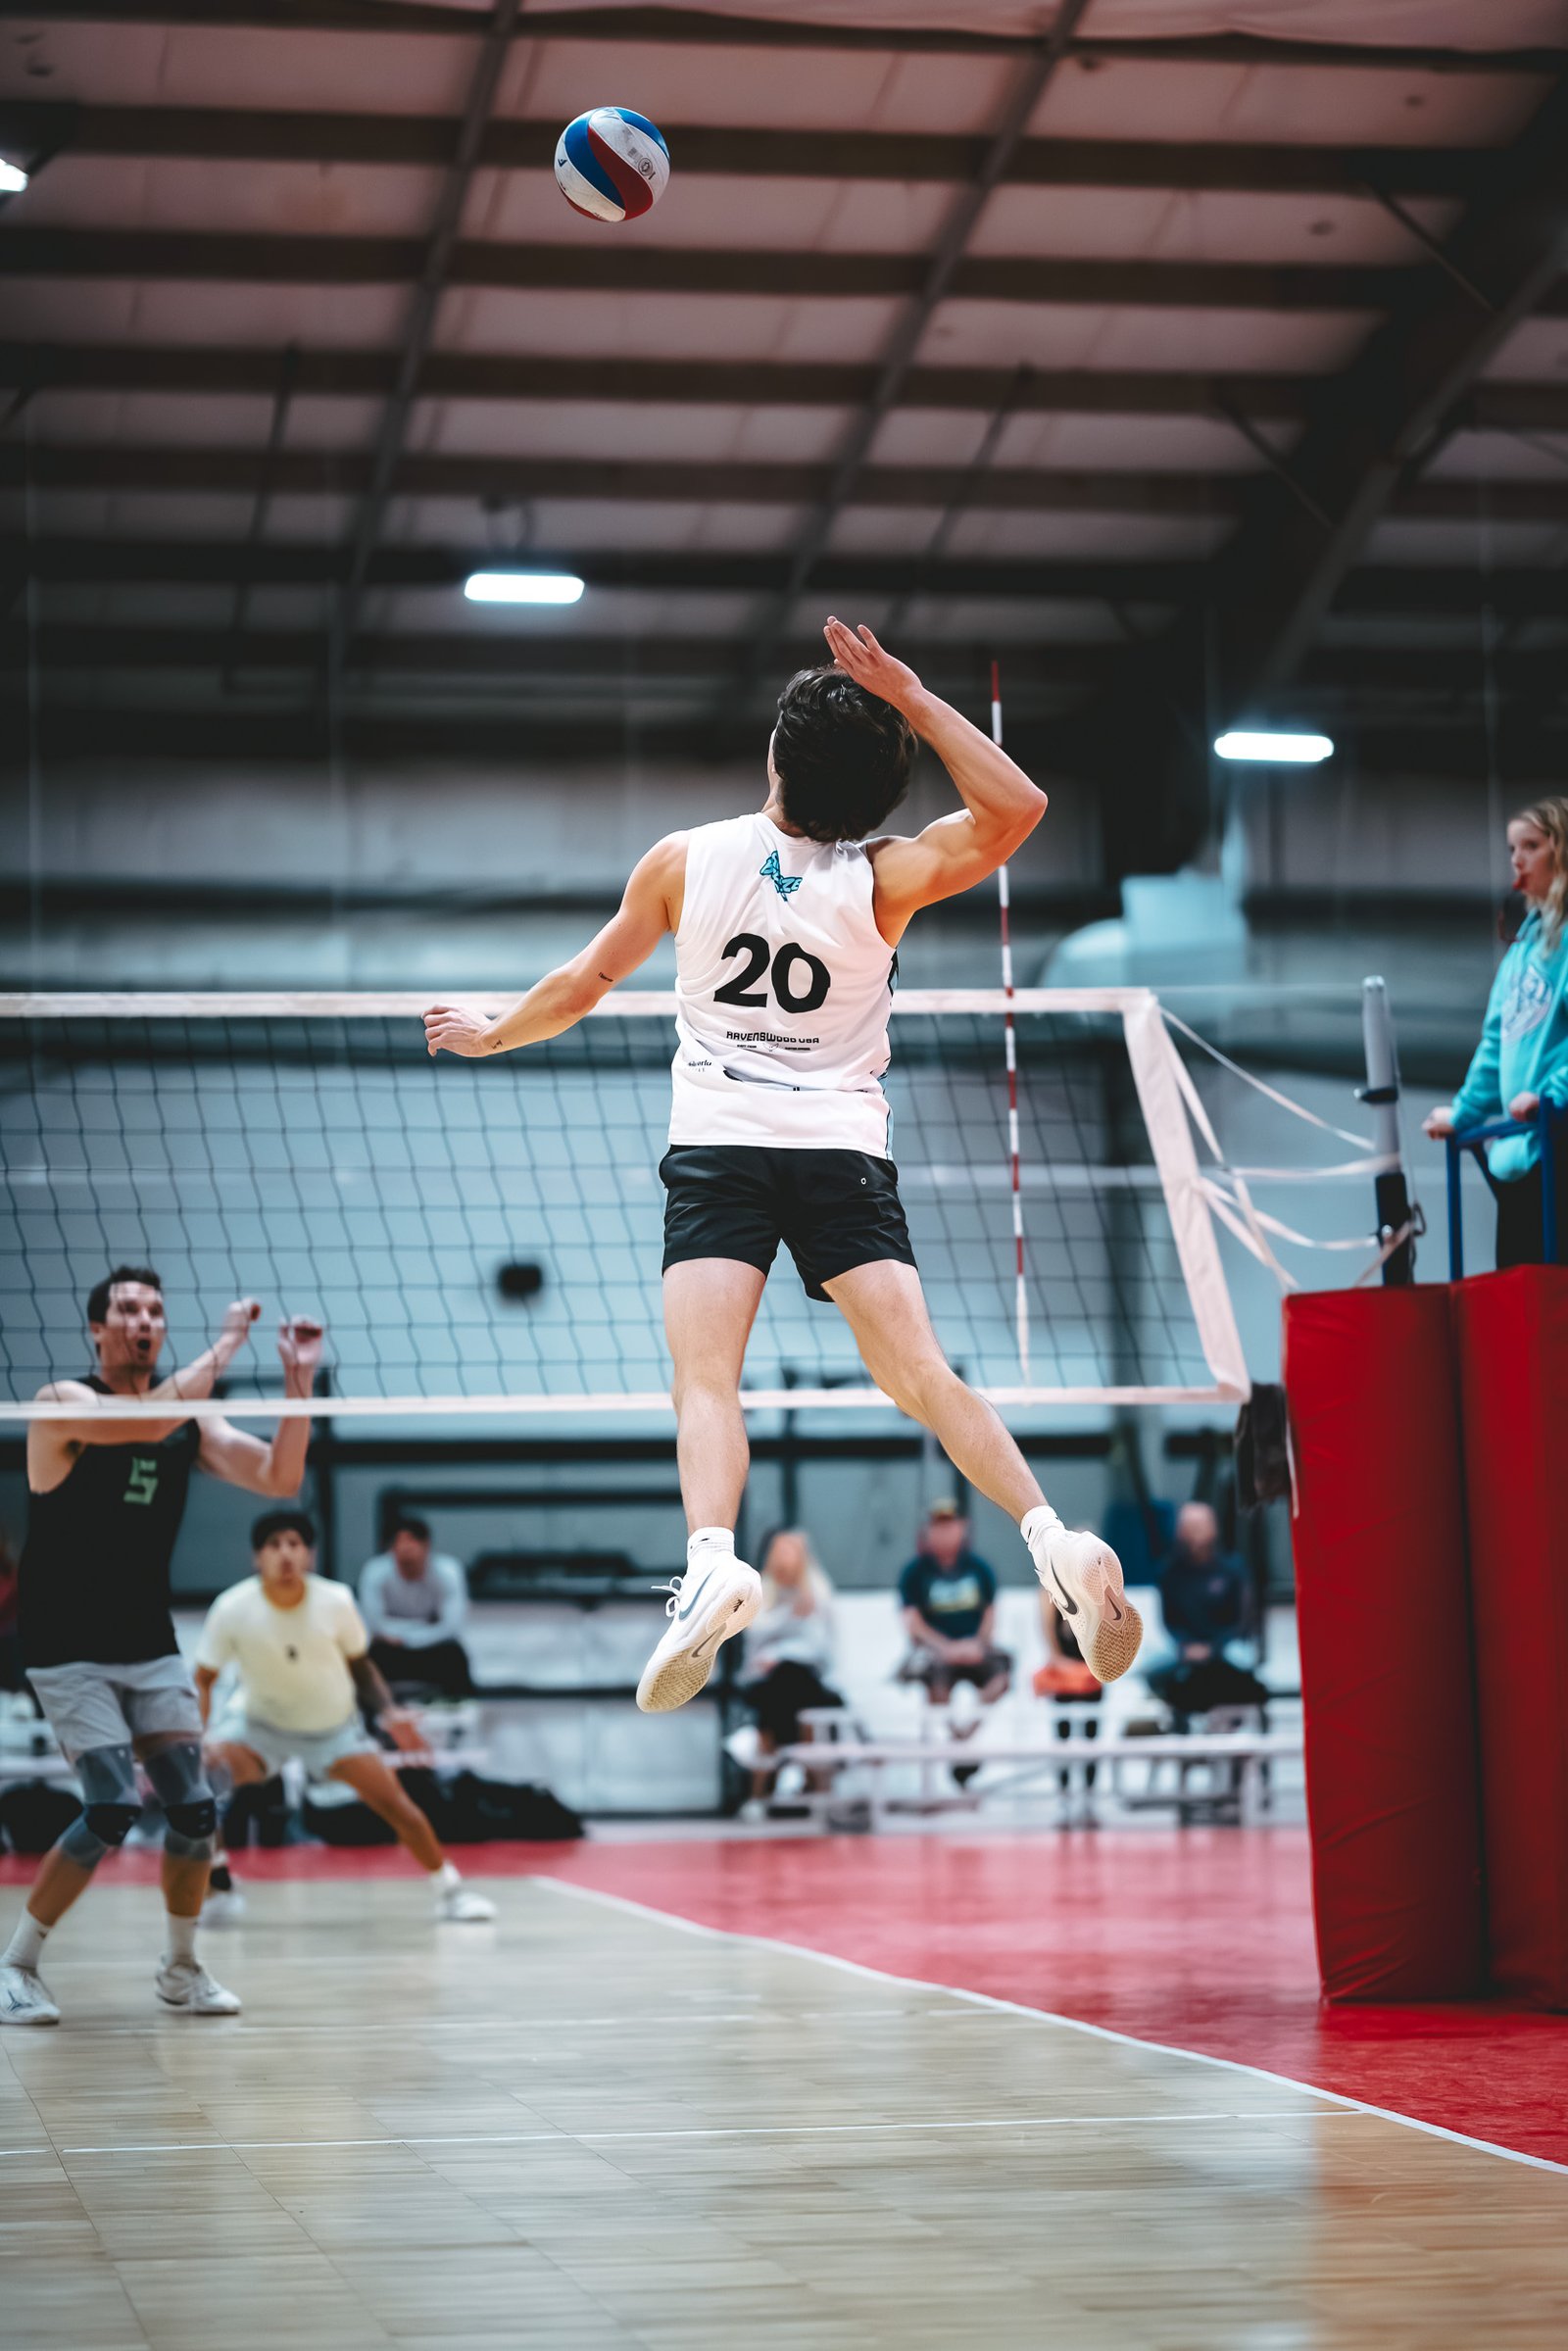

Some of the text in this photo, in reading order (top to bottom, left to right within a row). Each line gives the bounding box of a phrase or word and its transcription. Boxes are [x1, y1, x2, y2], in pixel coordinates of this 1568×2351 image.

[713, 933, 831, 1013] 20
[726, 1031, 796, 1043] RAVENSWOOD
[123, 1456, 158, 1505] 5
